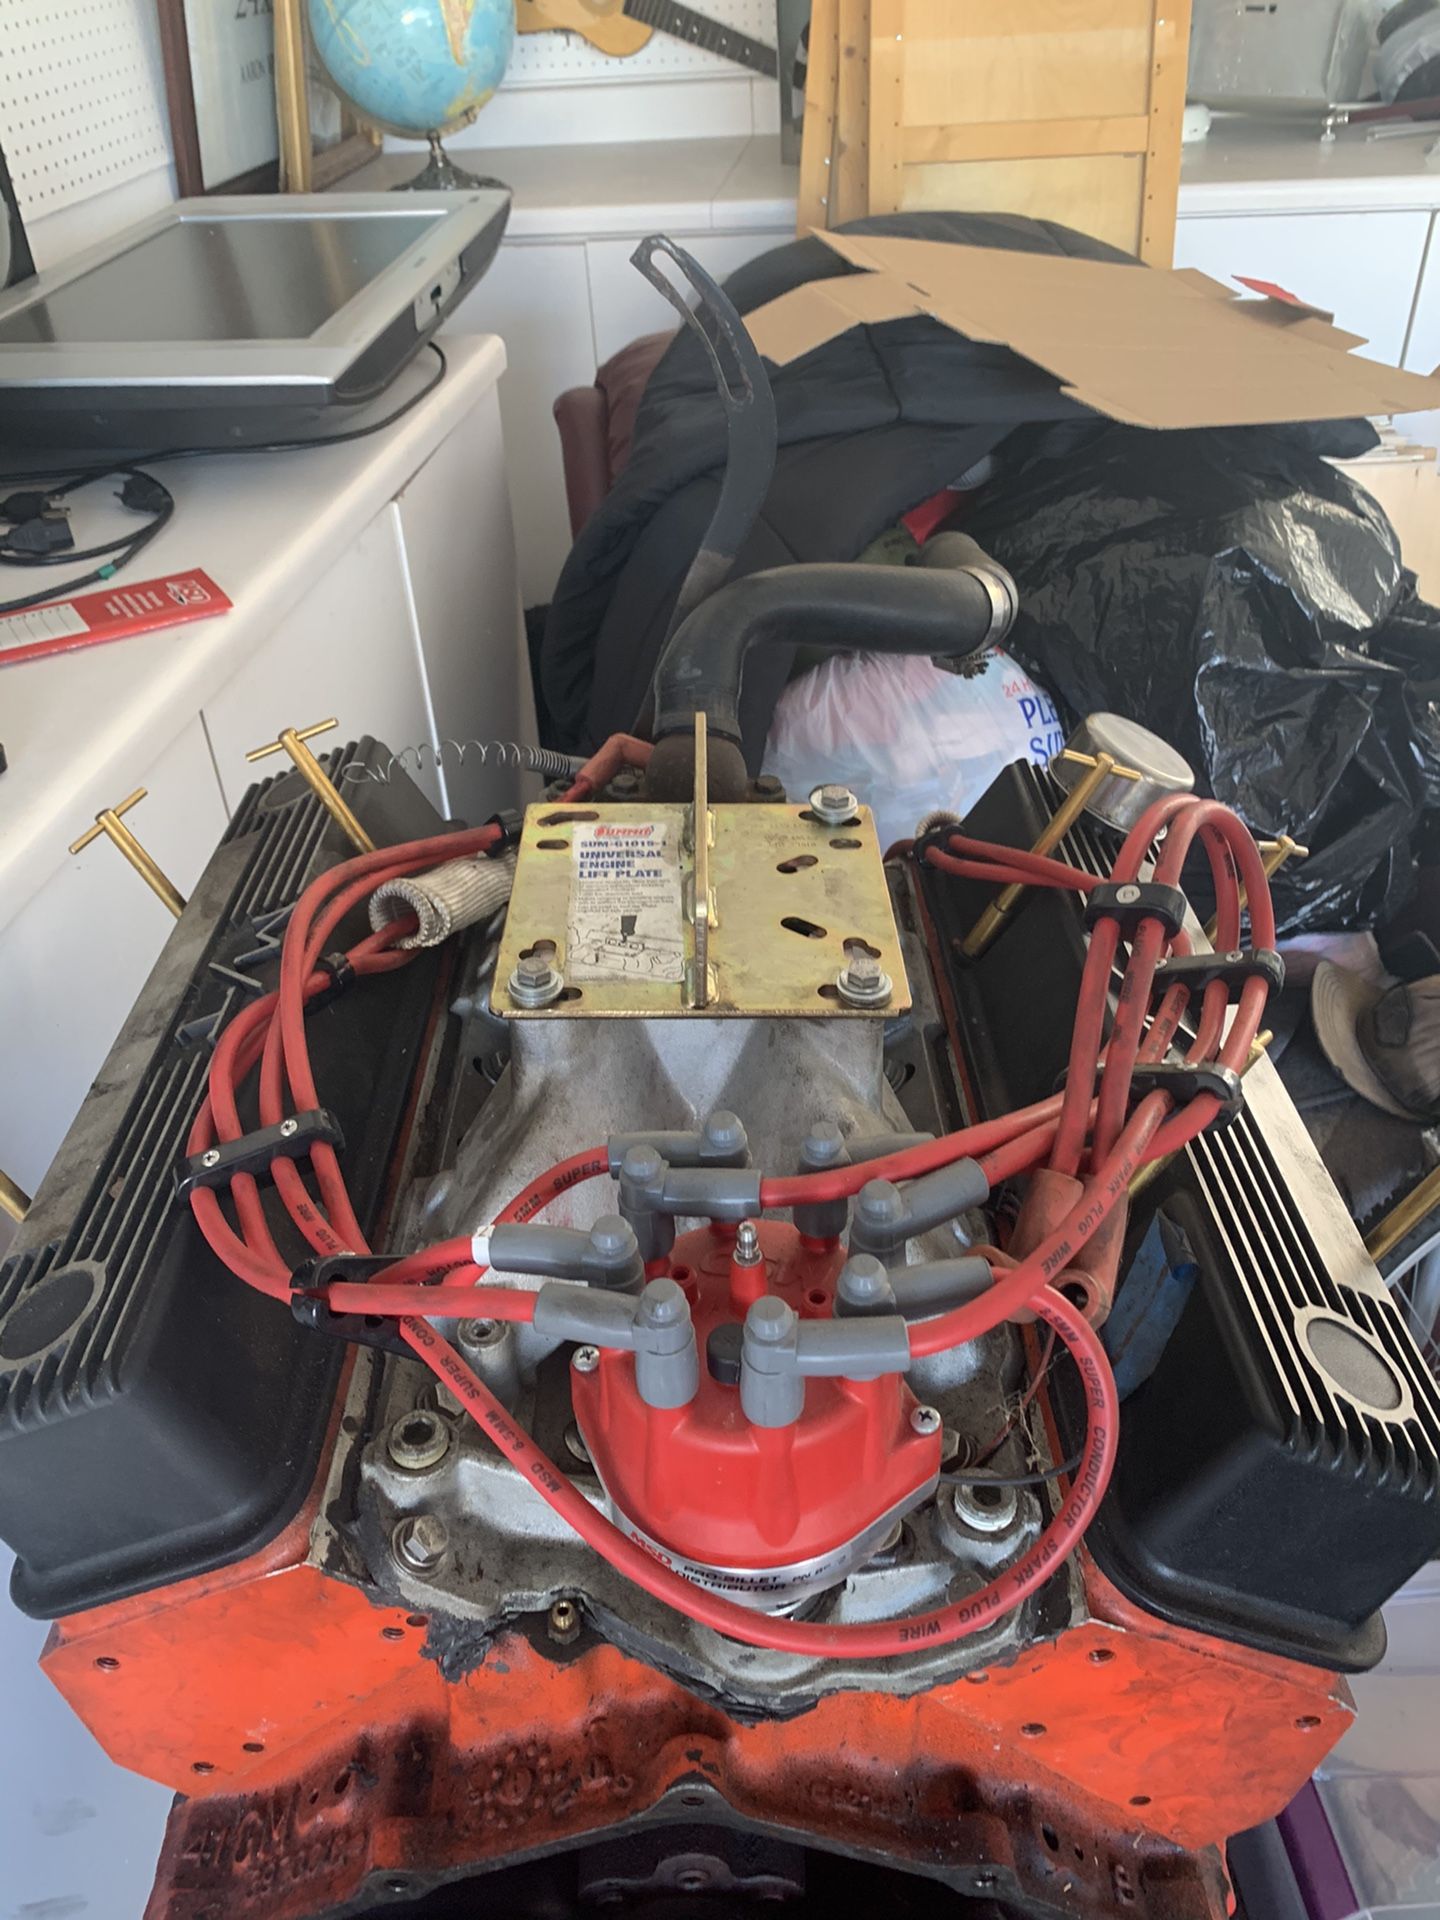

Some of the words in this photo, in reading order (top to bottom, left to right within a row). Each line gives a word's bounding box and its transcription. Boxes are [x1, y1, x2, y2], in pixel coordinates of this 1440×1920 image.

[579, 860, 635, 869] ENGINE
[580, 850, 664, 859] UNIVERSAL
[578, 870, 609, 879] LIFT
[615, 869, 663, 878] PLATE
[552, 1160, 602, 1191] SUPER
[1107, 1161, 1133, 1194] SPARK
[1078, 1203, 1104, 1237] PLUG
[1041, 1240, 1072, 1276] WIRE
[439, 1357, 481, 1399] SUPER
[1080, 1357, 1105, 1409] SUPER
[530, 1461, 563, 1493] MSD
[1062, 1426, 1107, 1529] CONDUCTOR
[1013, 1538, 1058, 1588] SPARK
[958, 1591, 1001, 1623] PLUG
[900, 1621, 942, 1642] WIRE
